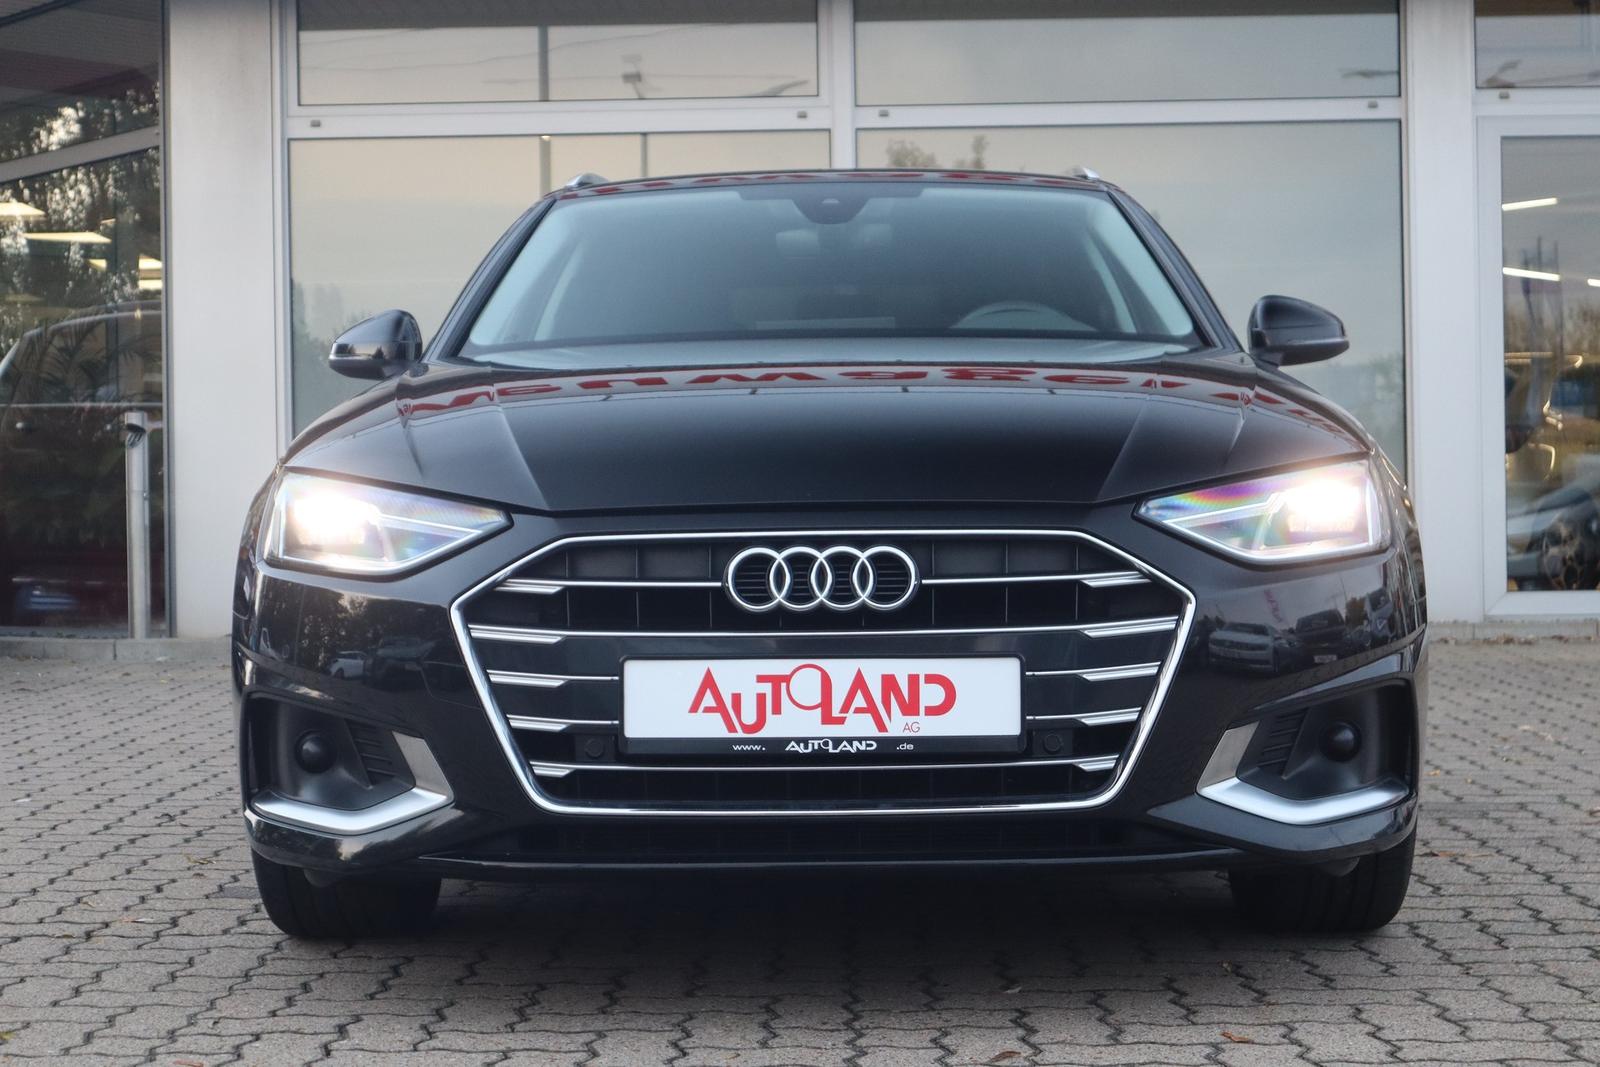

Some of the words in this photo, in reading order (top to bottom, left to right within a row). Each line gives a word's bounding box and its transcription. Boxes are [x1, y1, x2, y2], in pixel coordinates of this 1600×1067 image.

[688, 663, 957, 734] AUTOLAND
[902, 721, 921, 733] AG
[732, 743, 766, 751] www.
[785, 738, 877, 754] AUTOLAND
[896, 742, 914, 750] .de
